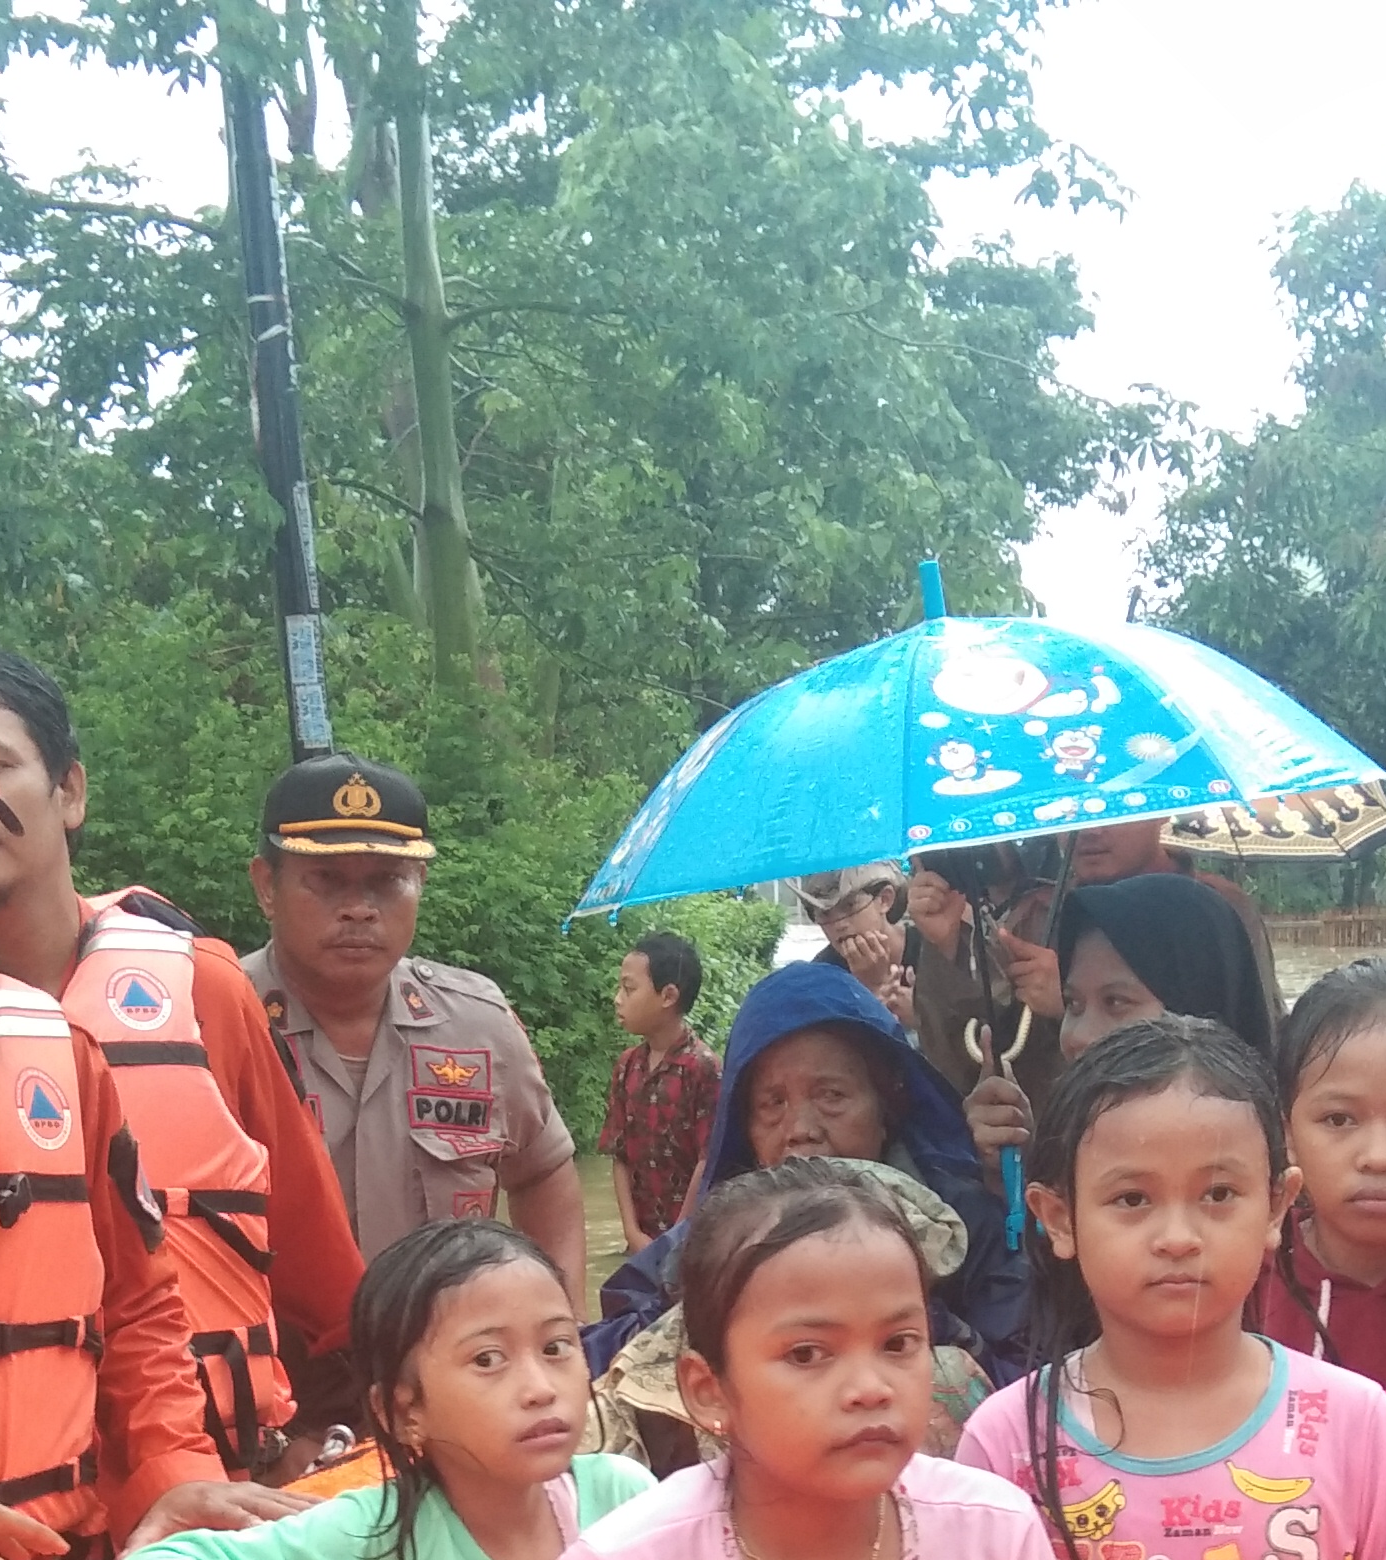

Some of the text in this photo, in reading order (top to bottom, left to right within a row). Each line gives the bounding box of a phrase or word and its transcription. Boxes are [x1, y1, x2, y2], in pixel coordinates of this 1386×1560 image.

[416, 1097, 488, 1127] POLRI
[1296, 1389, 1329, 1457] Kids
[1160, 1494, 1242, 1527] Kids
[1164, 1527, 1212, 1537] Zaman
